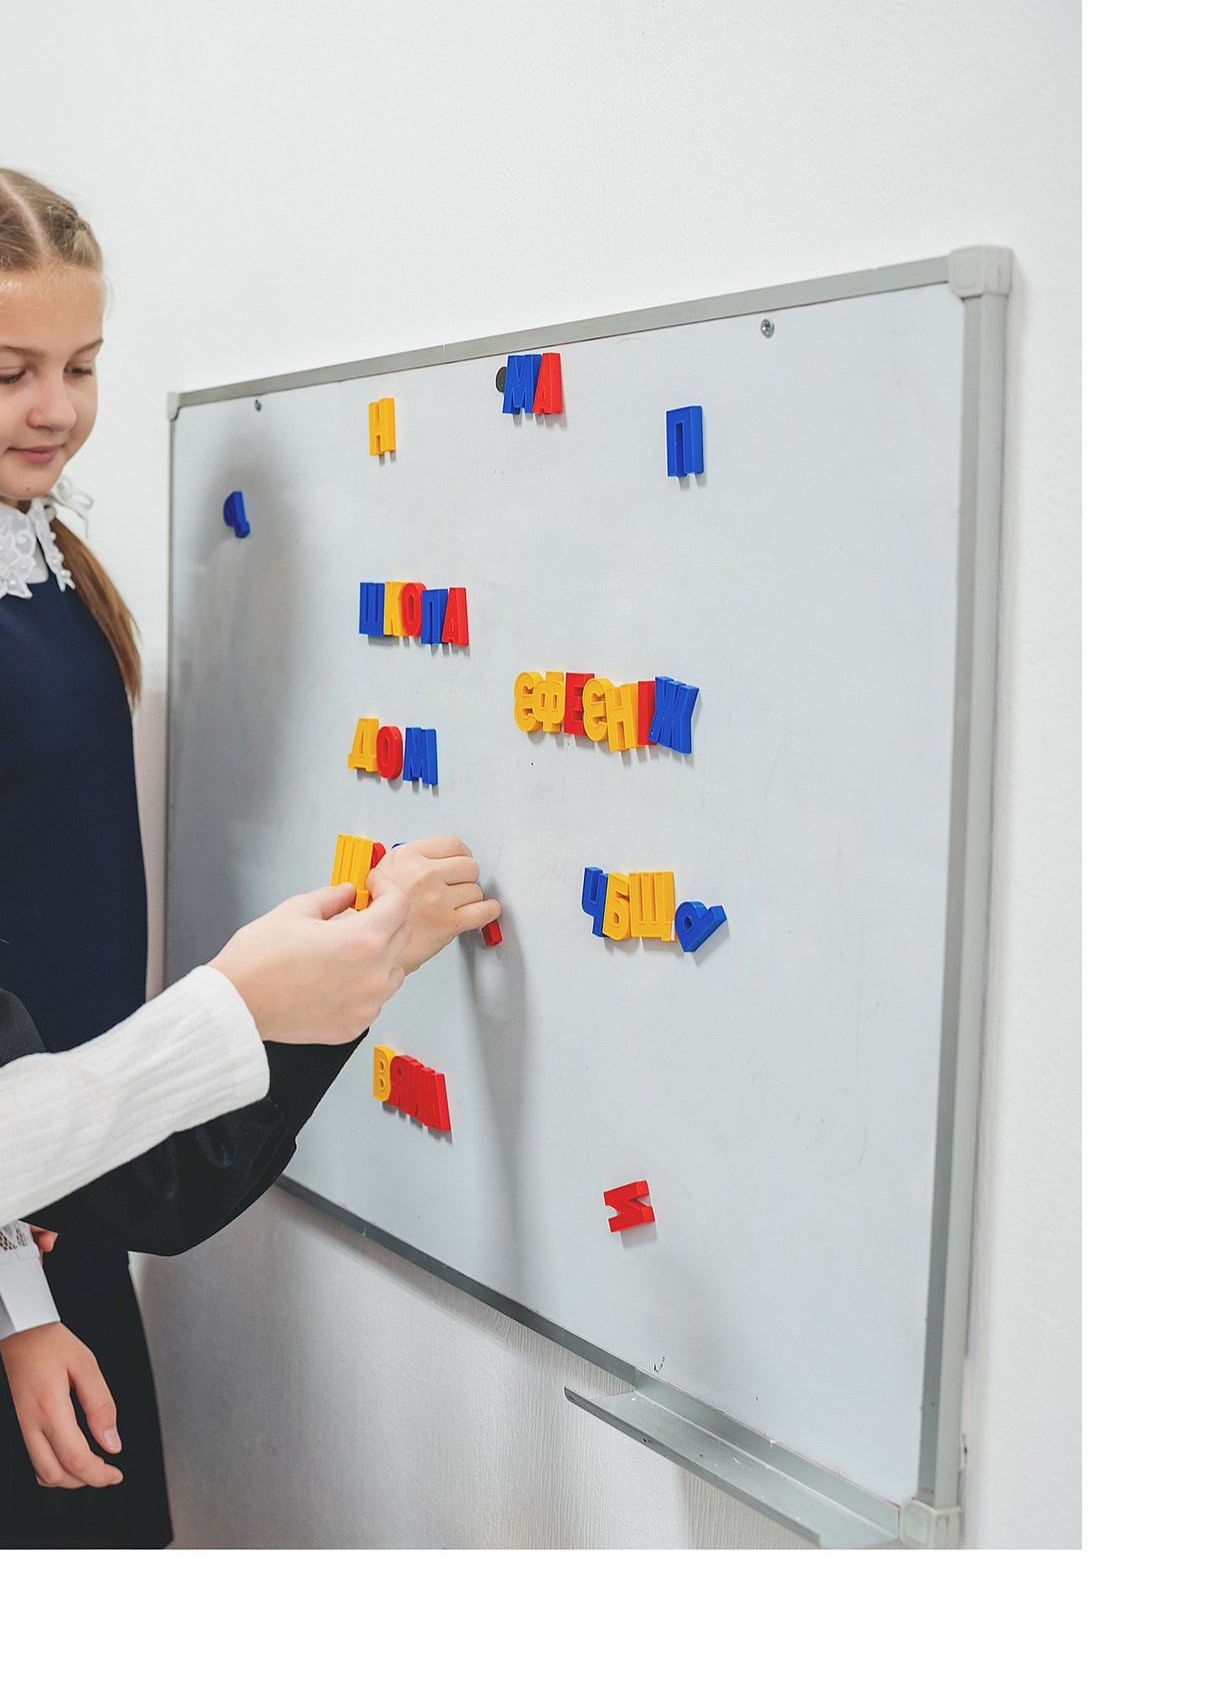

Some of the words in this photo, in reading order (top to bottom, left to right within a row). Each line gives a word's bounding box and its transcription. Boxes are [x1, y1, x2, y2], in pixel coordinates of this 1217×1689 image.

[502, 352, 562, 414] МА
[368, 397, 396, 455] Н
[666, 405, 704, 477] П
[359, 581, 470, 646] ШКОЛА
[348, 718, 438, 785] ДОМ
